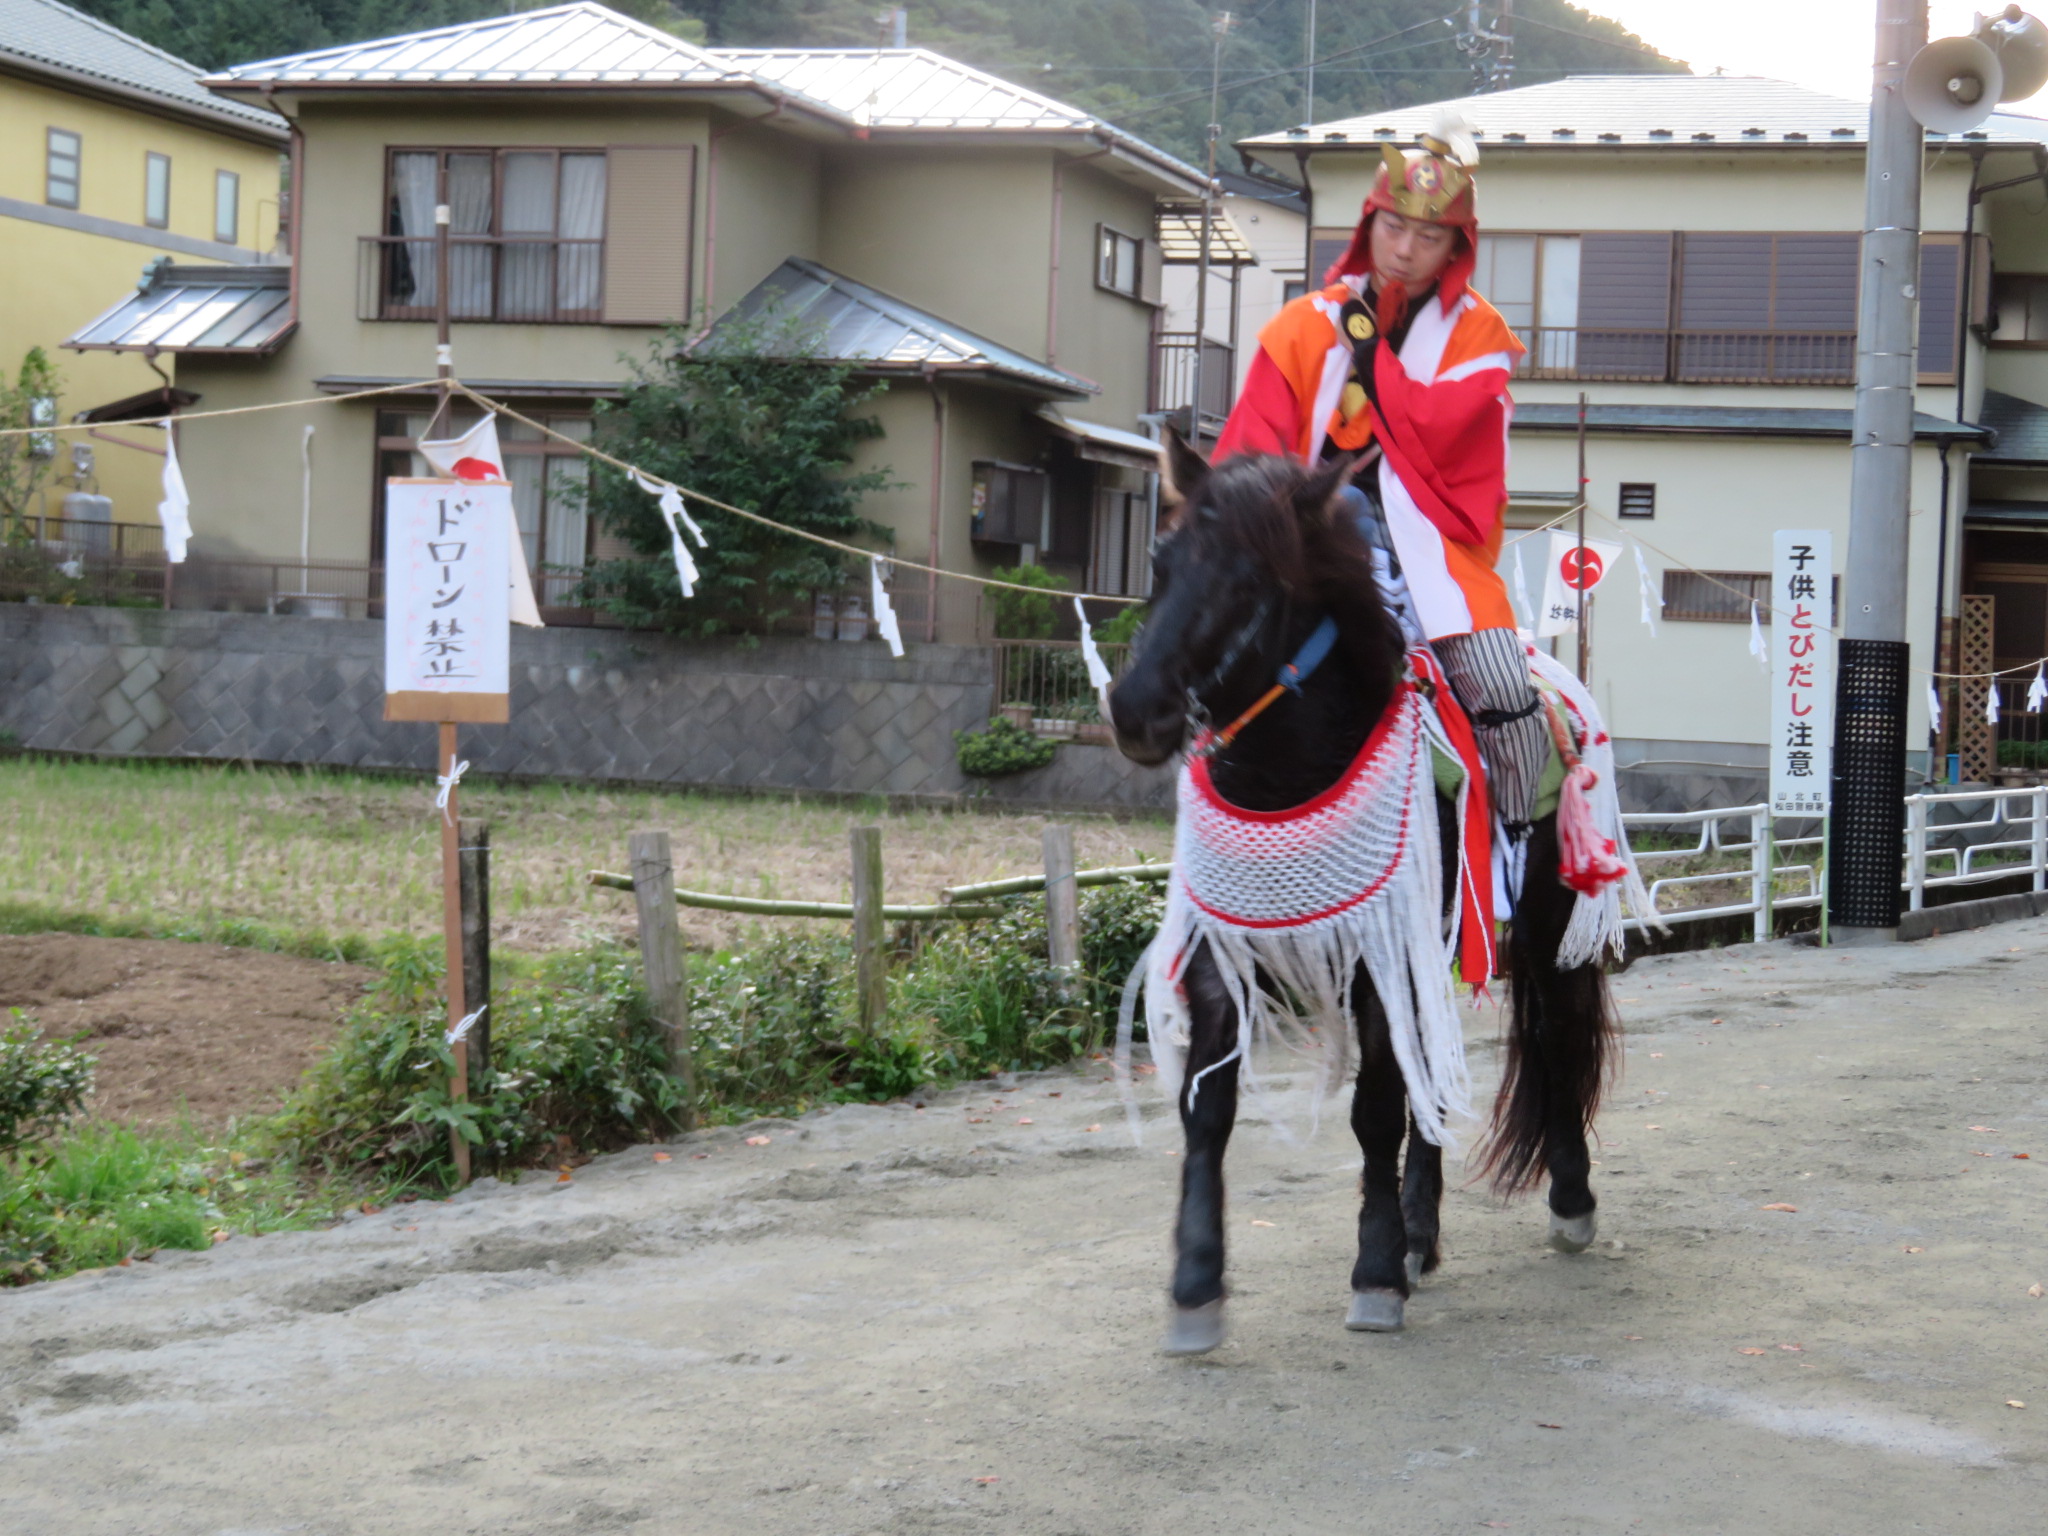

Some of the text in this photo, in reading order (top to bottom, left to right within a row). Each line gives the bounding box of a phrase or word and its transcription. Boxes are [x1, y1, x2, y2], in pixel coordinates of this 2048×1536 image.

[420, 498, 478, 678] ドローン禁止
[1786, 545, 1816, 777] 子供とびだし注意
